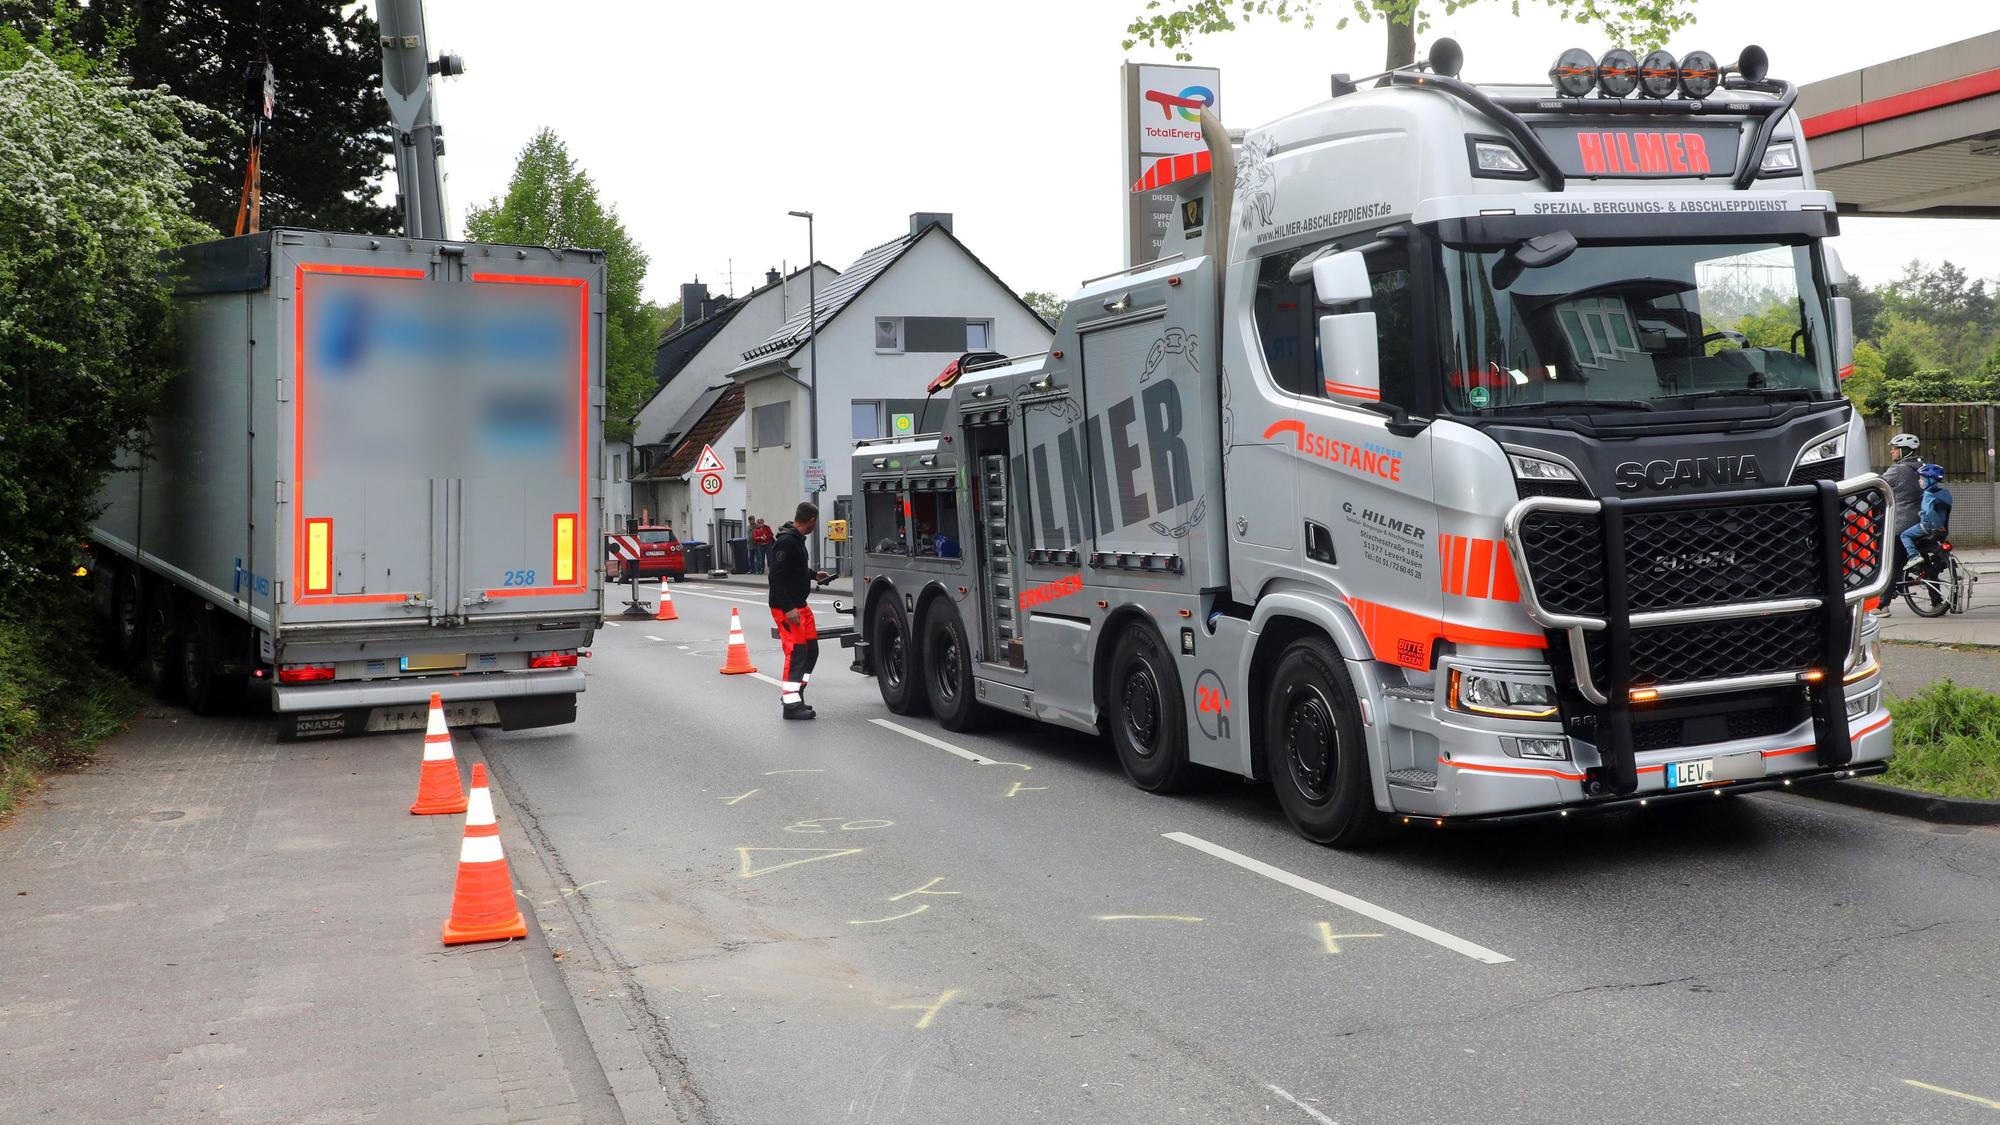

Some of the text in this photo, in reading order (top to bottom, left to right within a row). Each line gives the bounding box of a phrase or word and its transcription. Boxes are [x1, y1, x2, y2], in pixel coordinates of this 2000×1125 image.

[1145, 127, 1203, 141] TotalEnerg
[1576, 132, 1711, 173] HILMER
[1533, 200, 1788, 214] SPEZIAL- BERGUNGS- & ABSCHLEPPDIENST
[1256, 201, 1392, 244] www.HILMER-ABSCHLEPPDIENST.de
[1615, 454, 1765, 492] SCANIA
[705, 479, 718, 489] 30
[1342, 502, 1425, 540] G. HILMER
[1363, 541, 1423, 569] 51377 Leverkusen
[504, 570, 535, 587] 258
[1399, 639, 1424, 654] BITTE
[384, 708, 480, 721] TRAIERS
[1199, 687, 1230, 739] 24 h
[297, 720, 344, 730] KNAPEN
[1678, 763, 1704, 783] LEV
